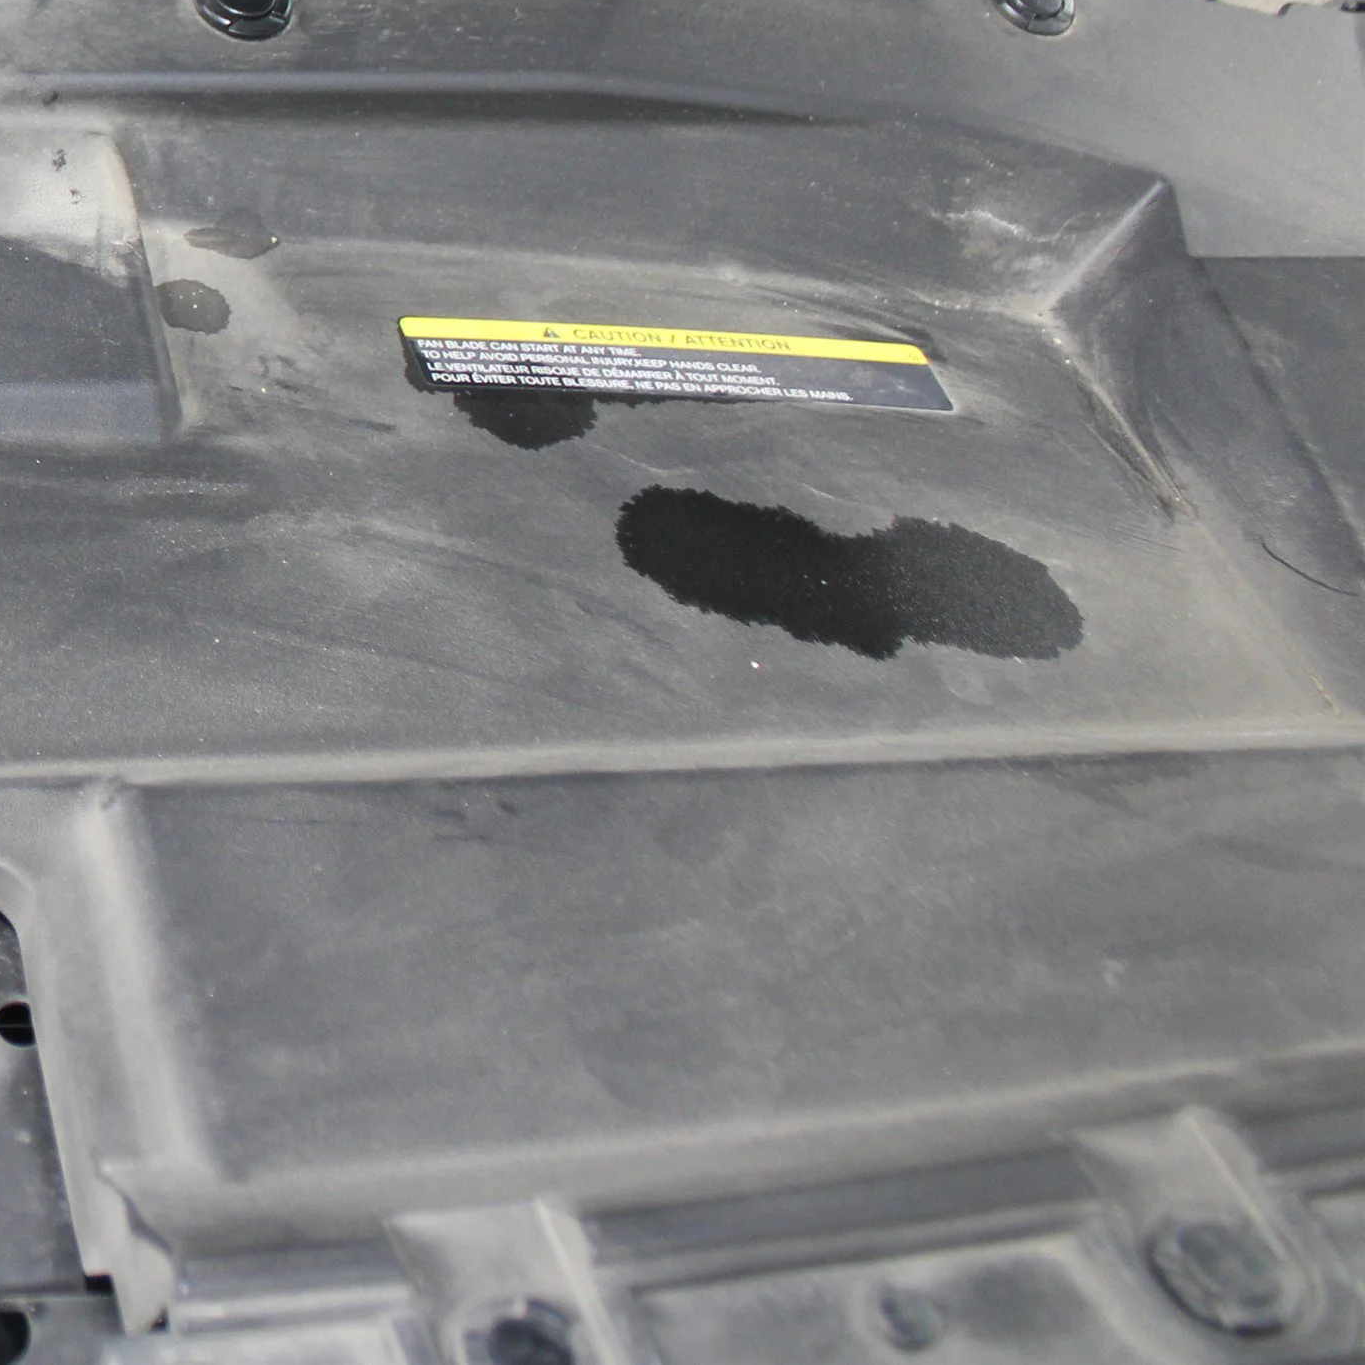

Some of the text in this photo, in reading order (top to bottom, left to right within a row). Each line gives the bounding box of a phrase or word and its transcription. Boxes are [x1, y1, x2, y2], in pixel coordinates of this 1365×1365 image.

[417, 339, 641, 357] FAN BLADE CAN START AT ANY TIME.
[573, 329, 662, 343] CAUTION
[685, 336, 790, 351] ATTENTION
[421, 350, 440, 359] TO
[443, 351, 475, 360] HELP
[479, 352, 521, 362] AVOID
[523, 354, 590, 365] PERSONAL
[670, 360, 715, 371] HANDS
[717, 363, 762, 373] CLEAR.
[427, 362, 780, 386] LE VENTILATEUR RISQUE DE DÉMARRER À TOUT MOMENT.
[432, 373, 471, 383] POUR
[472, 369, 517, 384] ÉVITER
[519, 376, 561, 385] TOUTE
[635, 381, 654, 390] NE
[656, 382, 681, 391] PAS
[683, 383, 701, 392] EN
[704, 384, 783, 396] APPROCHER
[783, 388, 808, 398] LES
[810, 390, 853, 401] MAINS.
